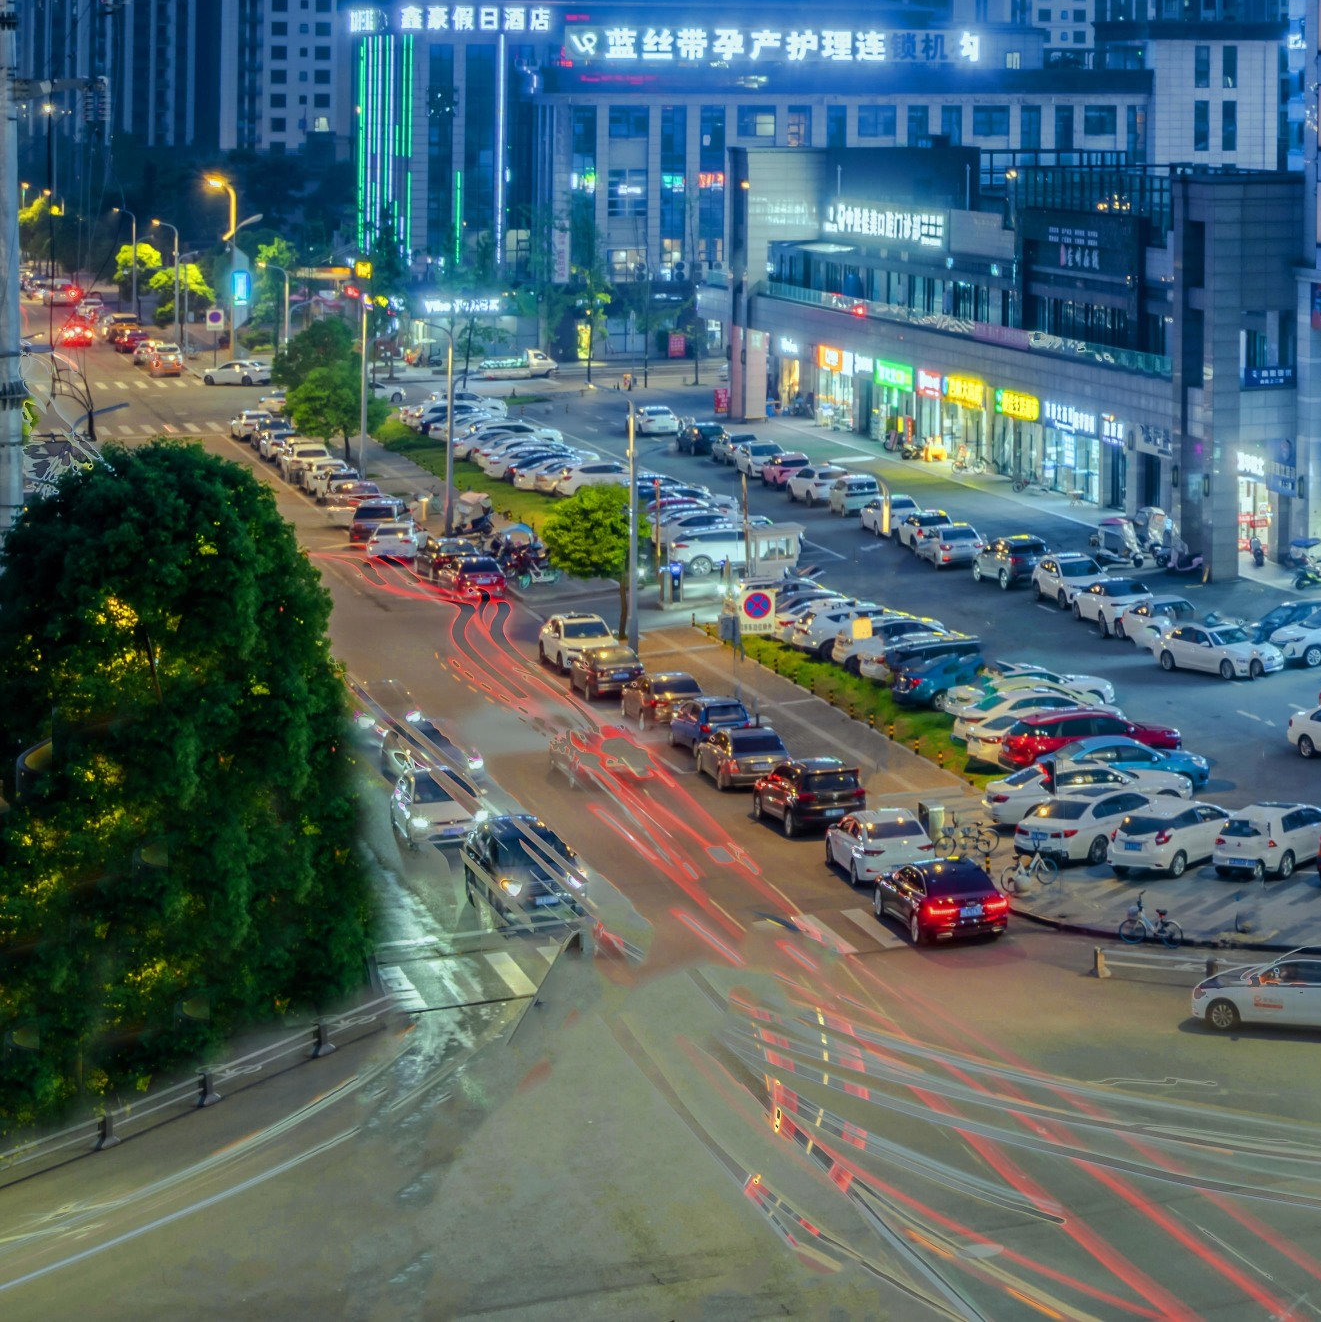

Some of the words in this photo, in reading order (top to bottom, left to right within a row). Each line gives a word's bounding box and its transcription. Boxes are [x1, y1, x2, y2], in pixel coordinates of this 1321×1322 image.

[401, 6, 550, 31] 鑫豪假日酒店
